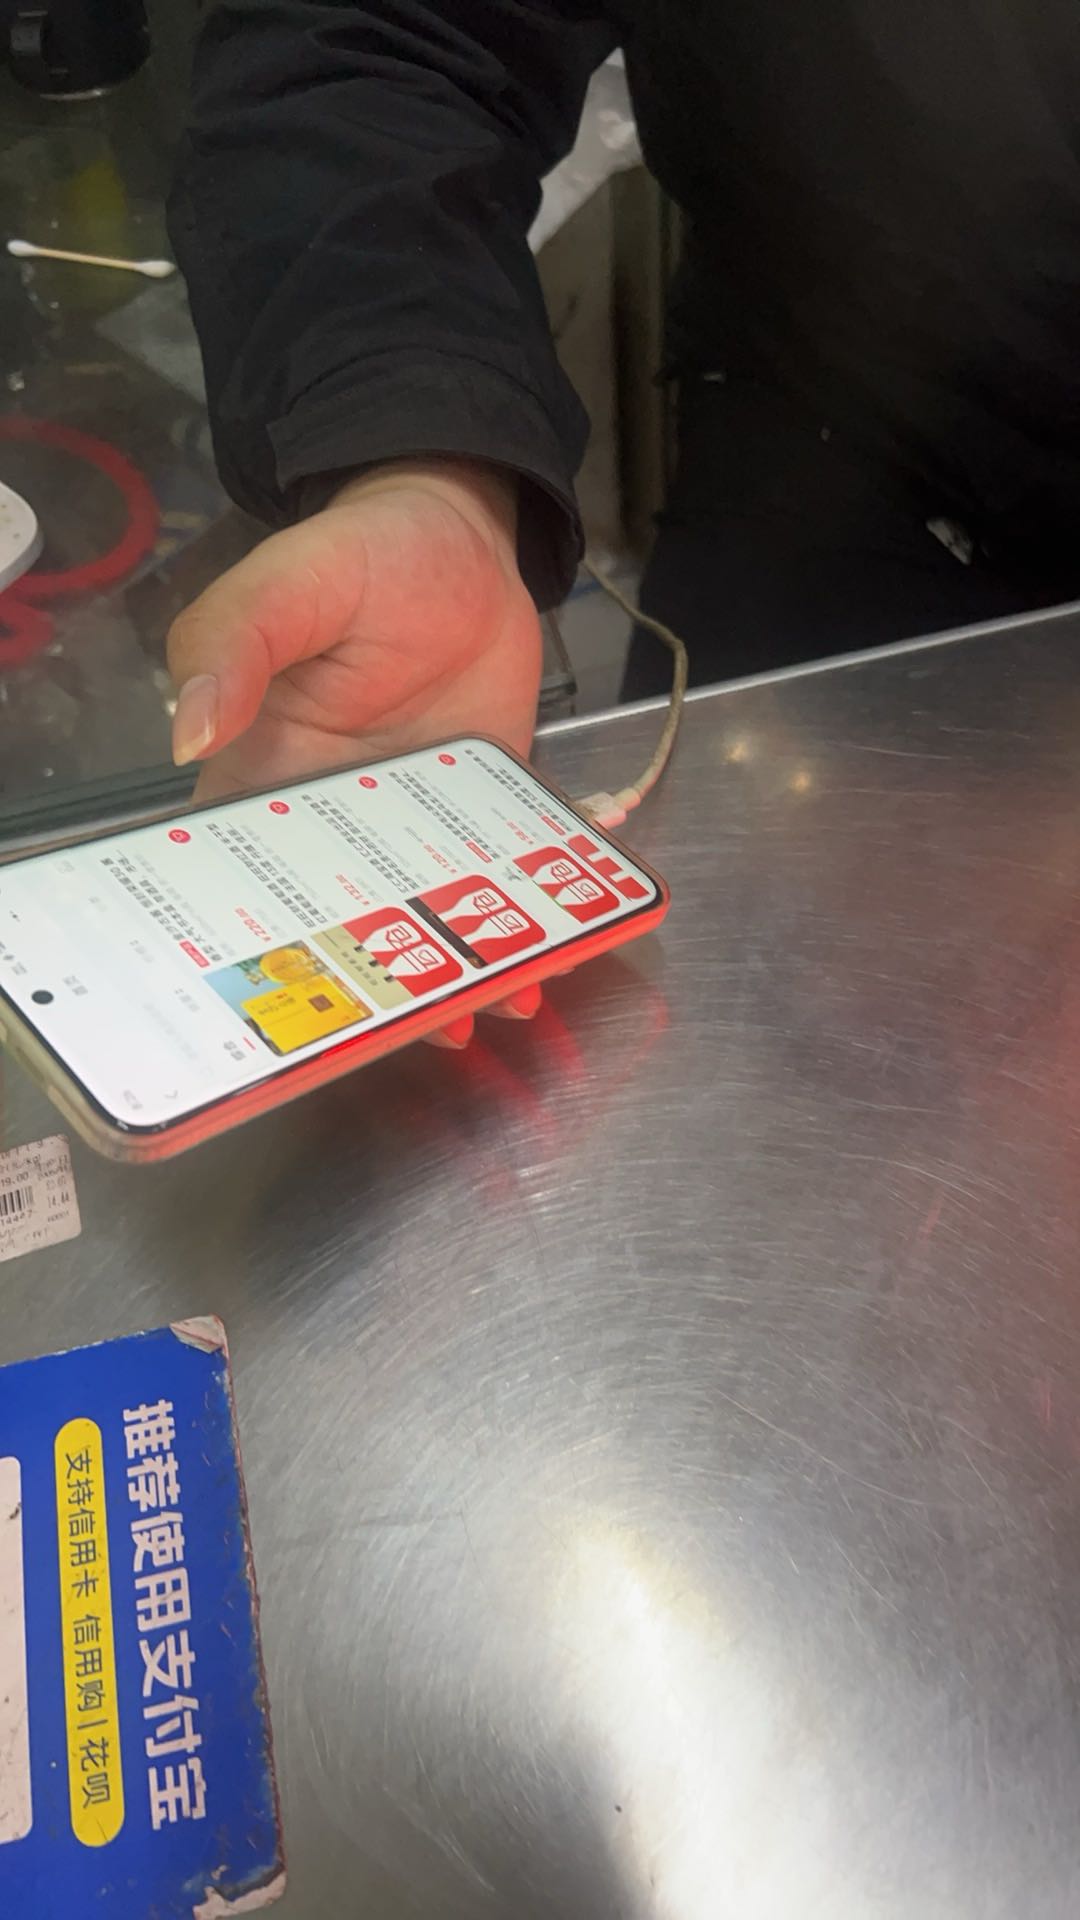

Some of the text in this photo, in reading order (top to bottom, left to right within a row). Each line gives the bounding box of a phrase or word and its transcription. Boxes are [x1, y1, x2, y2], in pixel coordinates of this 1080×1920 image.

[65, 1448, 99, 1598] 支持信用卡
[123, 1398, 207, 1832] 推荐使用支付宝
